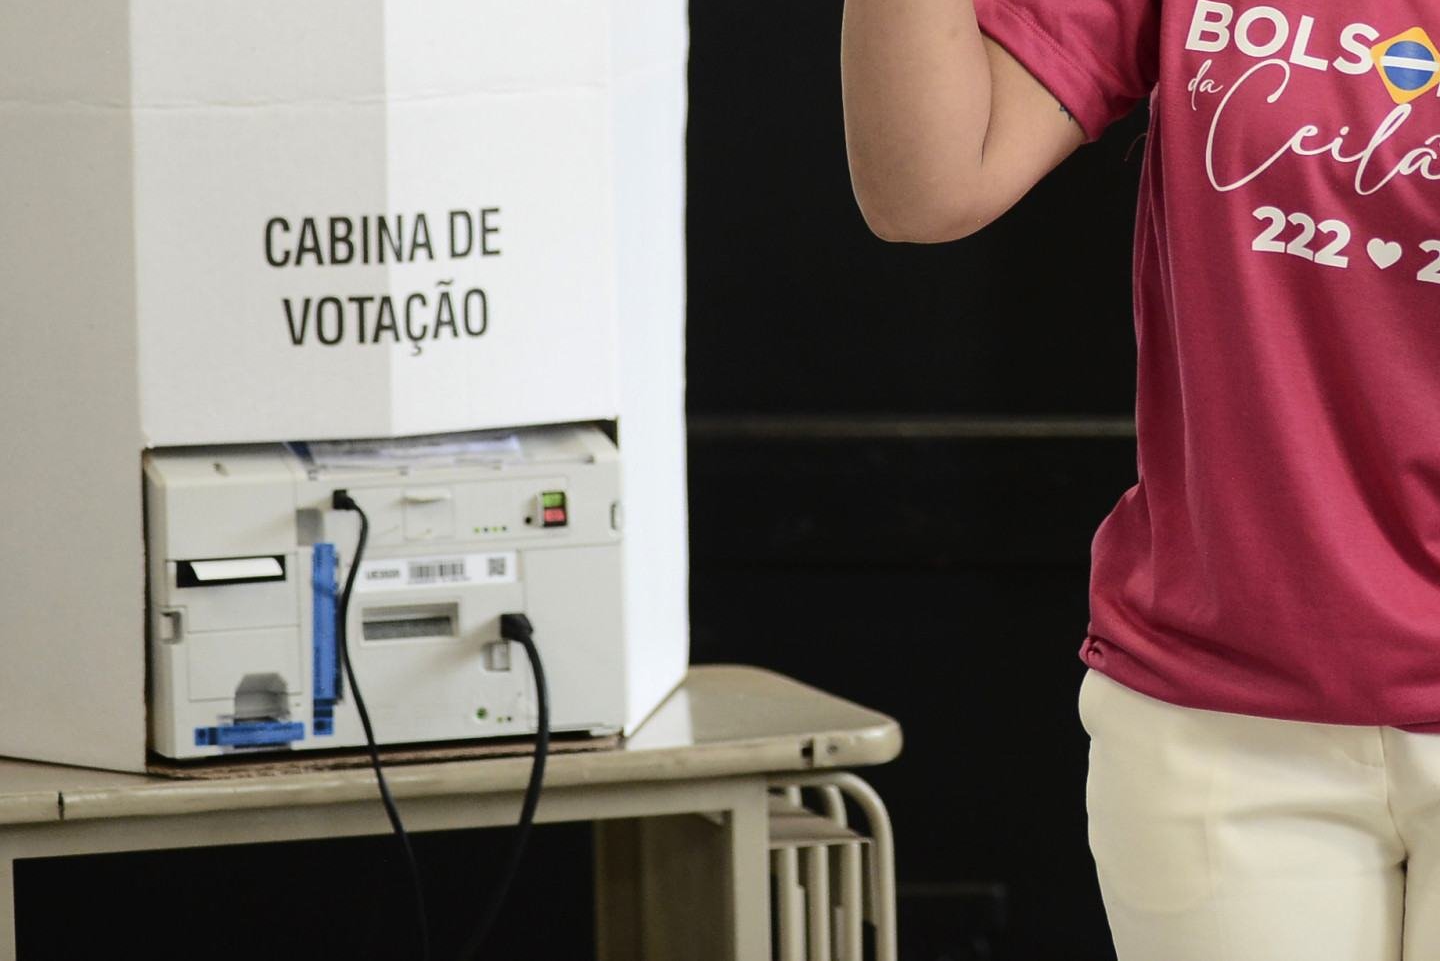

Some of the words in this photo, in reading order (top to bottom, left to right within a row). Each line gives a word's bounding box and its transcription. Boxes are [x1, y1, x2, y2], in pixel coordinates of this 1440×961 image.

[1188, 59, 1223, 111] da
[264, 212, 434, 268] CABINA
[449, 207, 501, 258] DE
[1251, 205, 1351, 268] 222
[282, 278, 488, 357] VOTAÇÃO
